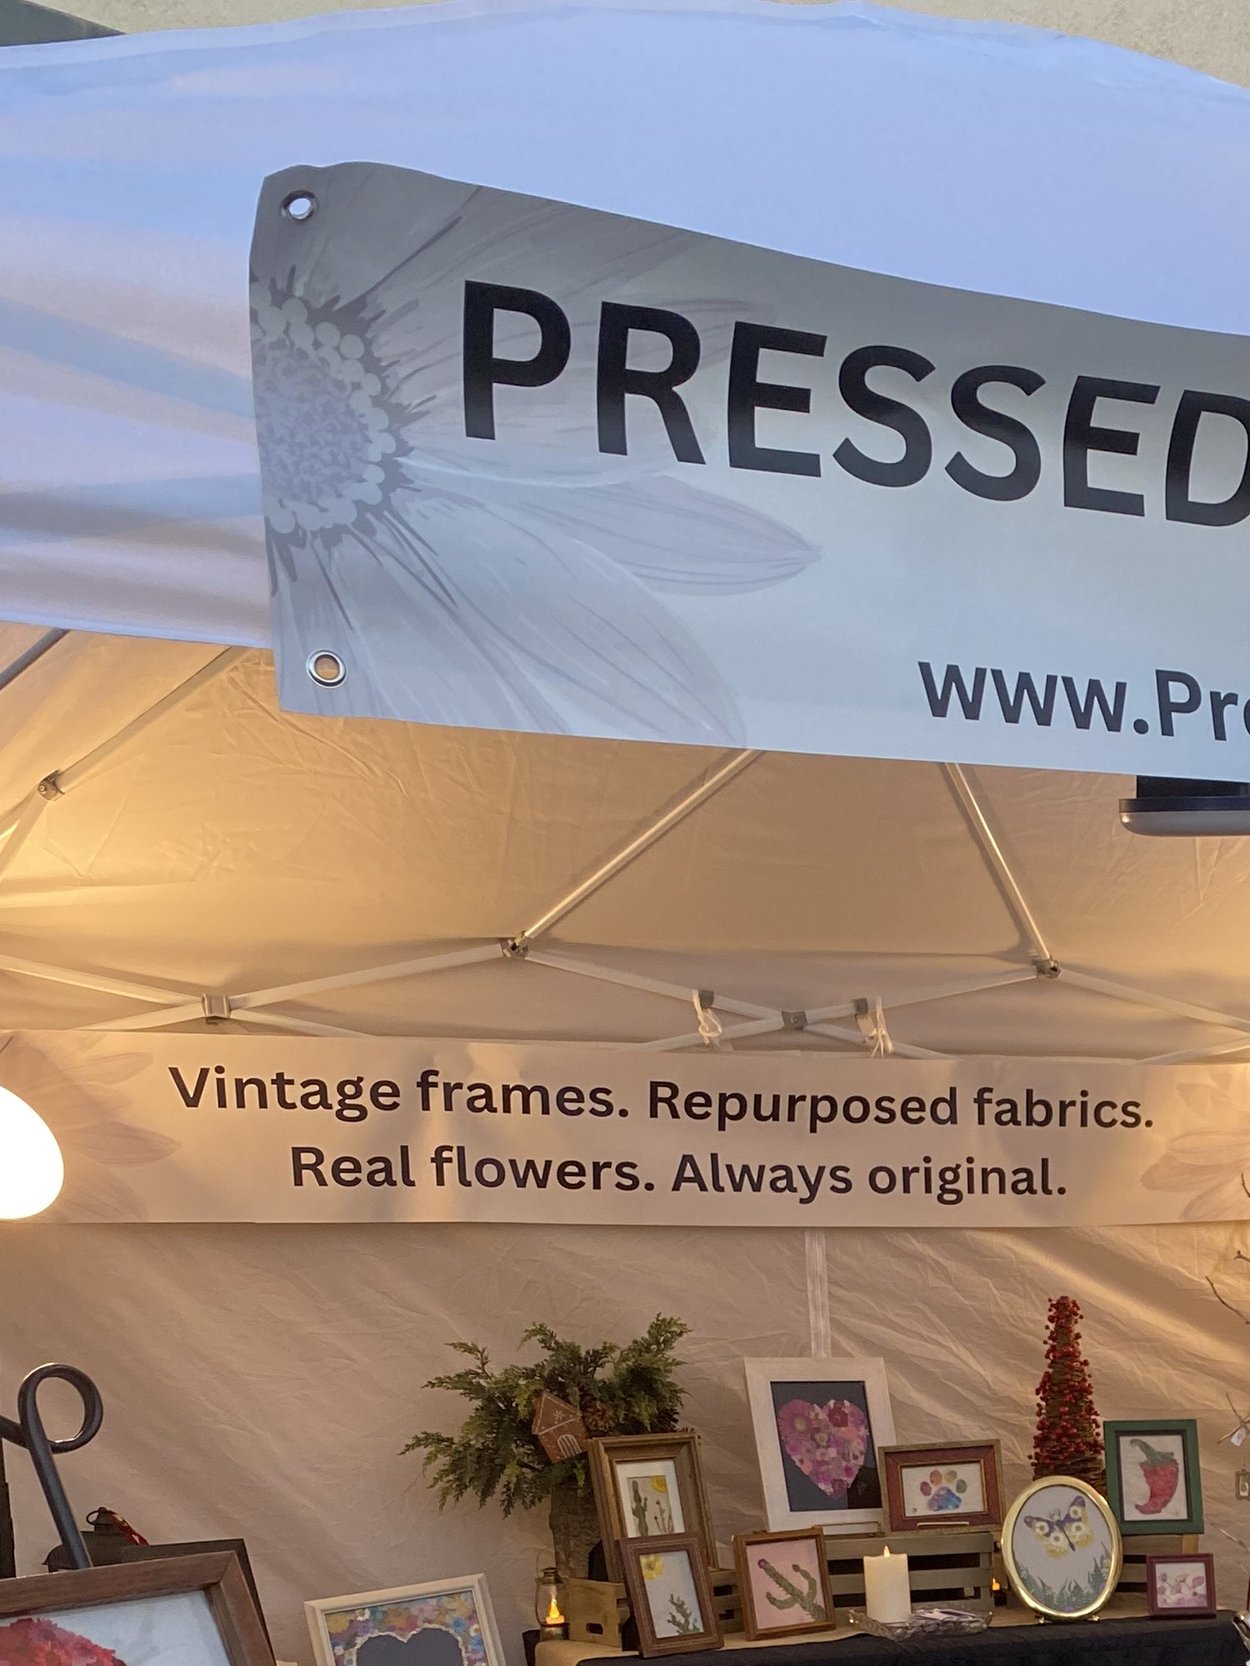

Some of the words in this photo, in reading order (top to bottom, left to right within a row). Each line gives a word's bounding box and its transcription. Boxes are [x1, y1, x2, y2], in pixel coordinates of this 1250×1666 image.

[168, 1066, 401, 1122] Vintage
[416, 1069, 629, 1118] frames.
[649, 1080, 958, 1134] Repurposed
[973, 1086, 1154, 1129] fabrics.
[291, 1144, 416, 1187] Real
[430, 1145, 655, 1192] flowers.
[671, 1152, 853, 1205] Always
[868, 1156, 1066, 1206] original.
